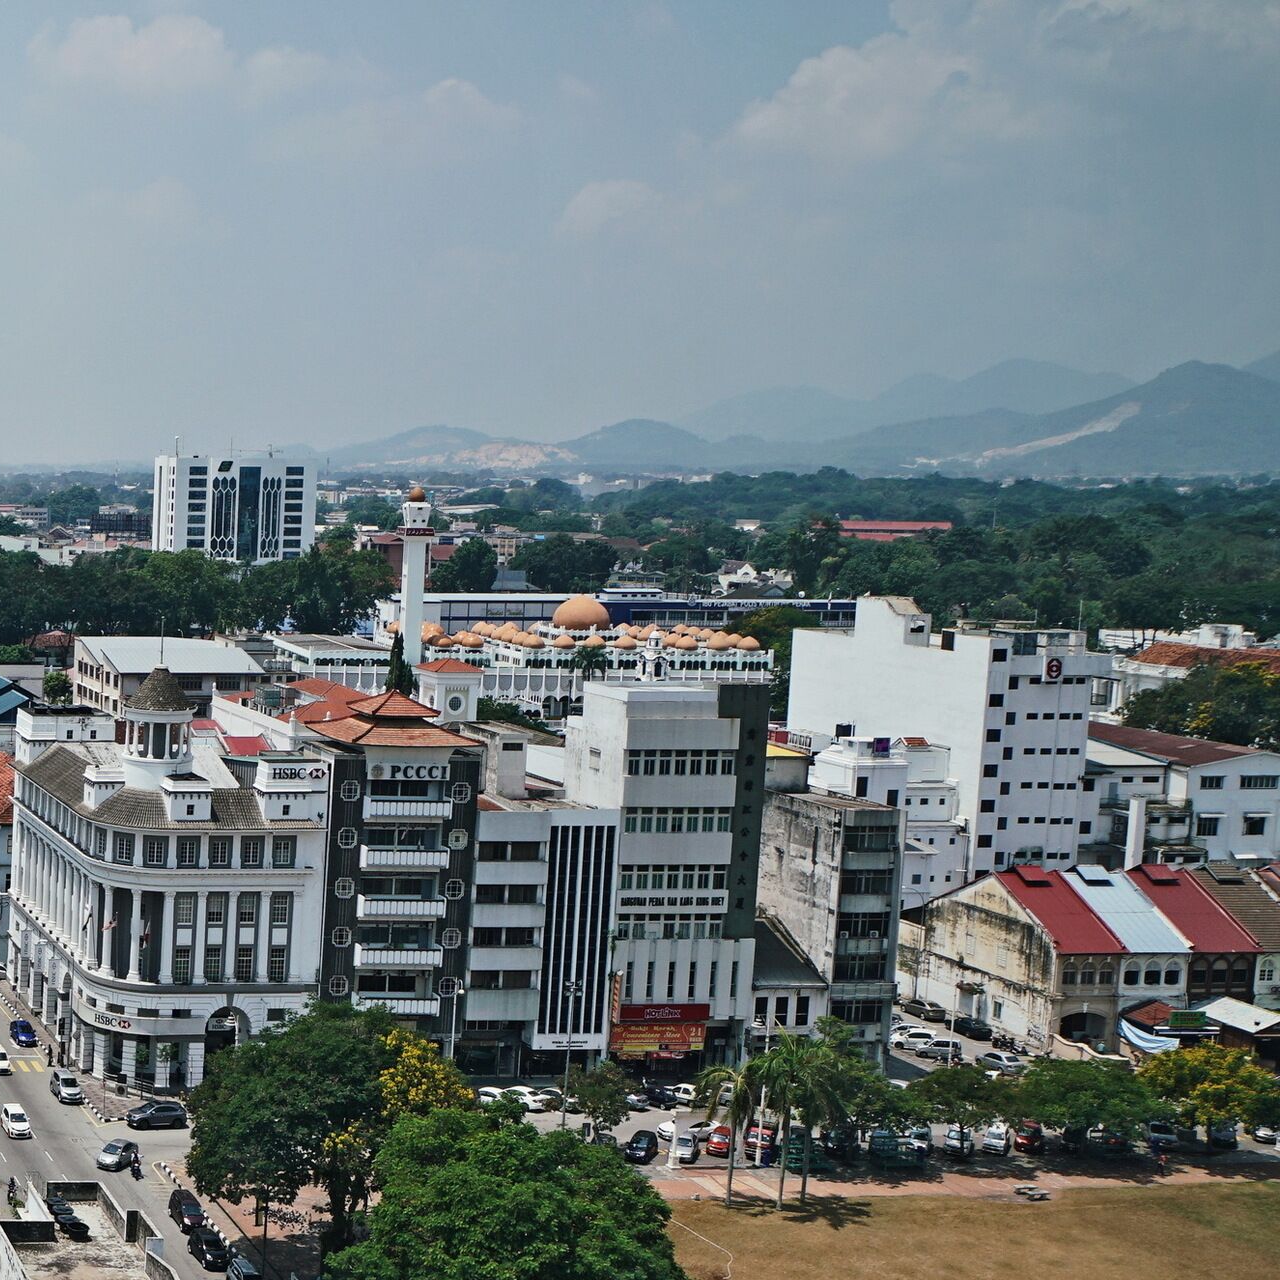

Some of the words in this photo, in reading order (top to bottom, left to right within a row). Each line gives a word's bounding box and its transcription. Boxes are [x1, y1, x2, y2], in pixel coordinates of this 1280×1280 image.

[272, 768, 307, 780] HSBC
[390, 765, 448, 779] PCCCI
[94, 1013, 118, 1028] HSBC
